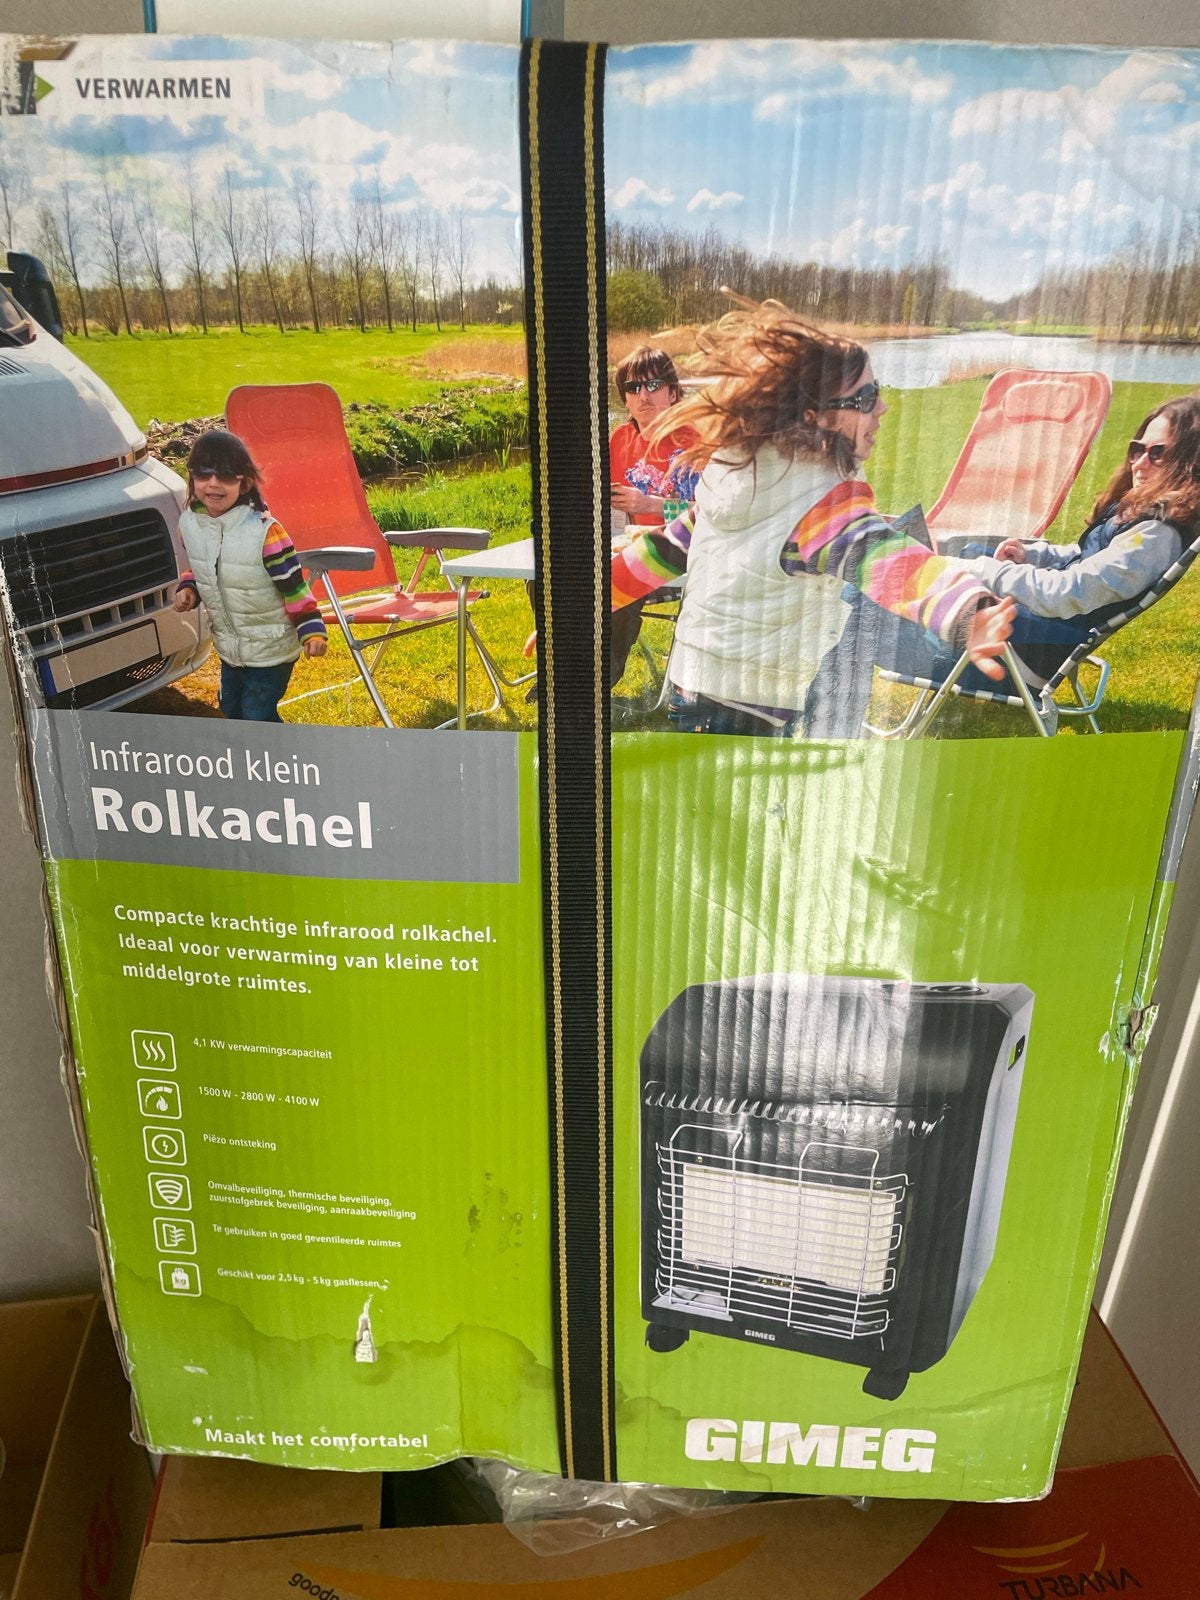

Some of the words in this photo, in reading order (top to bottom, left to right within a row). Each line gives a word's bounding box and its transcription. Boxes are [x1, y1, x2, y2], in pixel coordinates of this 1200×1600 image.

[75, 78, 231, 99] VERWARMEN
[90, 741, 234, 780] Infrarood
[246, 750, 321, 786] klein
[91, 787, 373, 849] Rolkachel
[114, 905, 205, 927] Compacte
[211, 912, 298, 938] krachtige
[305, 920, 395, 940] infrarood
[402, 925, 497, 943] rolkachel.
[118, 934, 174, 953] Ideaal
[180, 942, 220, 957] voor
[227, 947, 338, 971] verwarming
[344, 954, 378, 969] van
[385, 954, 443, 971] kleine
[450, 956, 479, 972] tot
[122, 962, 231, 990] middelgrote
[237, 976, 312, 994] ruimtes.
[193, 1037, 206, 1047] 4,1
[210, 1039, 225, 1049] KW
[228, 1043, 332, 1059] verwarmingscapaciteit
[199, 1087, 221, 1097] 1500
[222, 1089, 231, 1098] W
[241, 1091, 264, 1101] 2800
[266, 1093, 275, 1102] W
[285, 1096, 307, 1106] 4100
[310, 1097, 319, 1106] W
[203, 1133, 226, 1145] Piëzo
[229, 1138, 276, 1151] ontsteking
[208, 1180, 286, 1198] Omvalbeveiliging,
[288, 1189, 337, 1202] thermische
[339, 1194, 392, 1206] beveiliging,
[209, 1194, 275, 1208] zuurstofgebrek
[276, 1199, 327, 1214] beveiliging,
[330, 1206, 416, 1220] aanraakbeveiliging
[212, 1224, 222, 1233] Te
[225, 1225, 267, 1238] gebruiken
[269, 1229, 278, 1239] in
[281, 1231, 302, 1241] goed
[305, 1233, 365, 1246] geventileerde
[368, 1238, 401, 1248] ruimtes
[217, 1268, 254, 1280] Geschikt
[256, 1273, 275, 1281] voor
[333, 1278, 380, 1287] gasflessen
[745, 1330, 775, 1341] GIMEG
[204, 1428, 265, 1446] Maakt
[272, 1430, 303, 1446] het
[310, 1432, 428, 1449] comfortabel
[684, 1417, 937, 1474] GIMEG
[999, 1567, 1143, 1600] TURBANA
